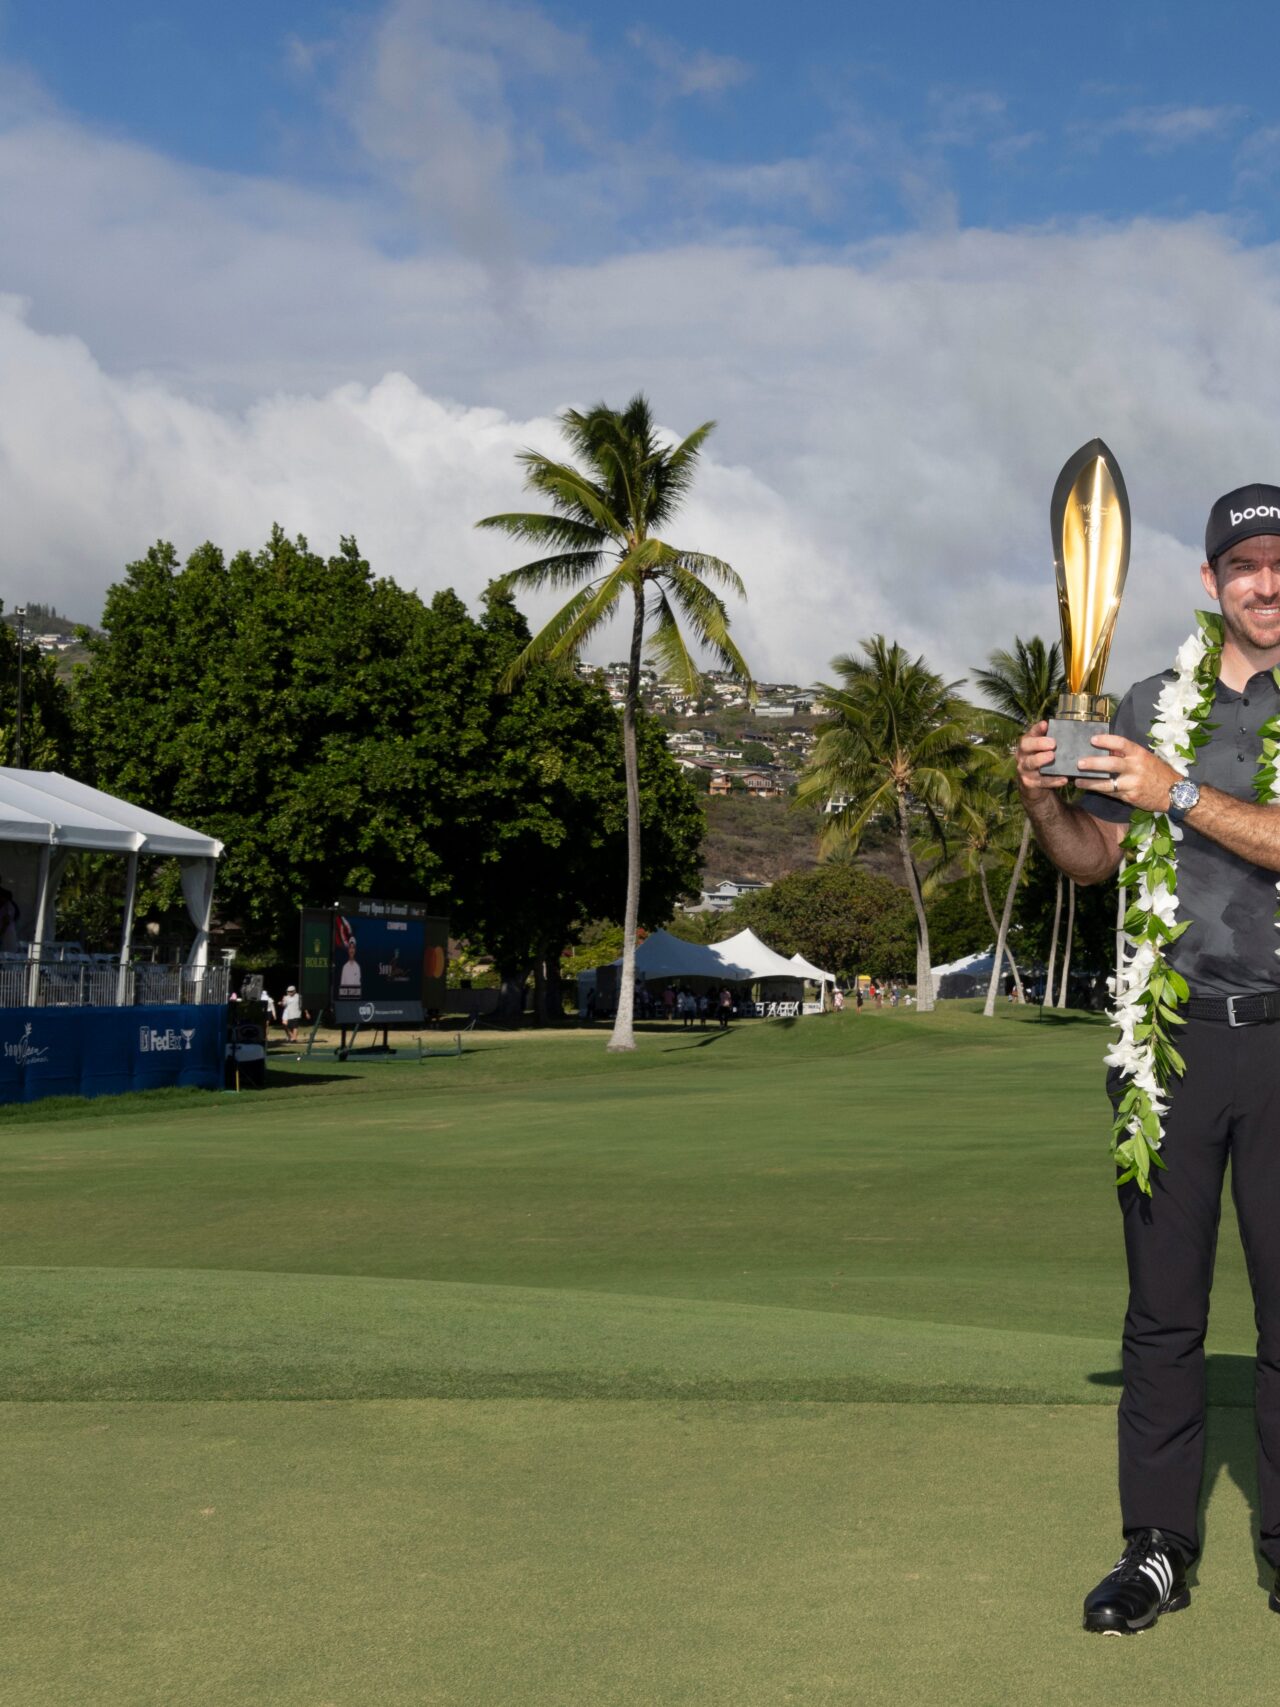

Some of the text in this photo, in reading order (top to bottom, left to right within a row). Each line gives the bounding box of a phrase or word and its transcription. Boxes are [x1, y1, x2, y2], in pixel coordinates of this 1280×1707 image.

[304, 957, 328, 968] ROLEX
[150, 1029, 182, 1051] FedEx
[4, 1041, 22, 1058] Sony
